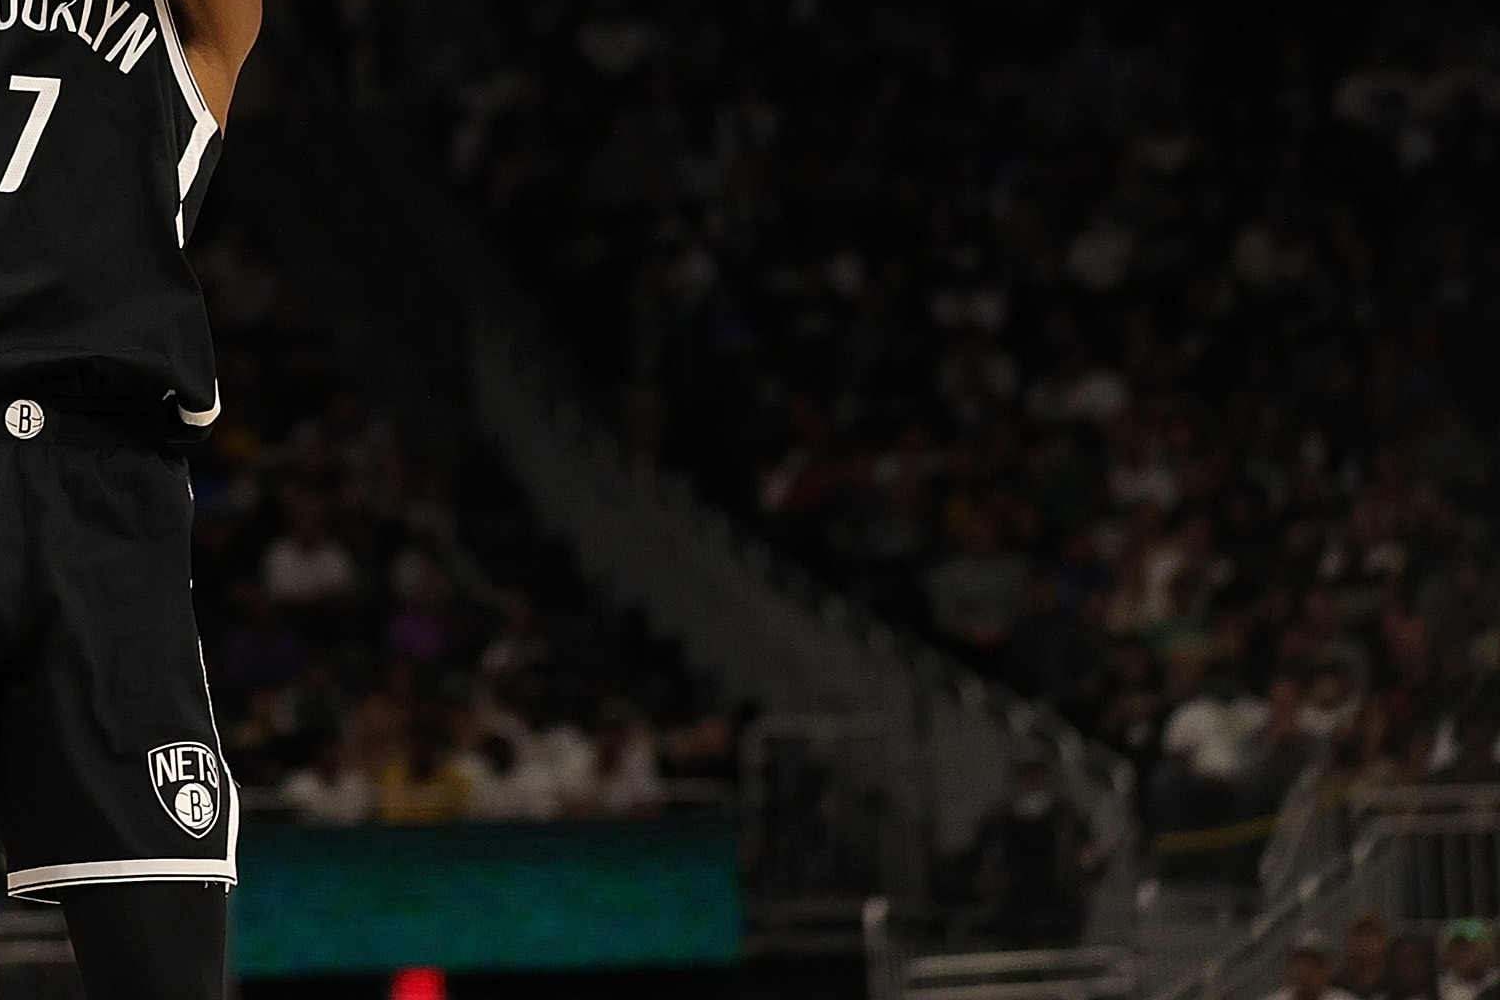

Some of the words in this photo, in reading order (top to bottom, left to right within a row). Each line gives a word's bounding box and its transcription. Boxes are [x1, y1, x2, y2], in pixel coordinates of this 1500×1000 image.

[19, 404, 32, 433] B
[155, 747, 219, 788] NETS
[190, 790, 203, 823] B
